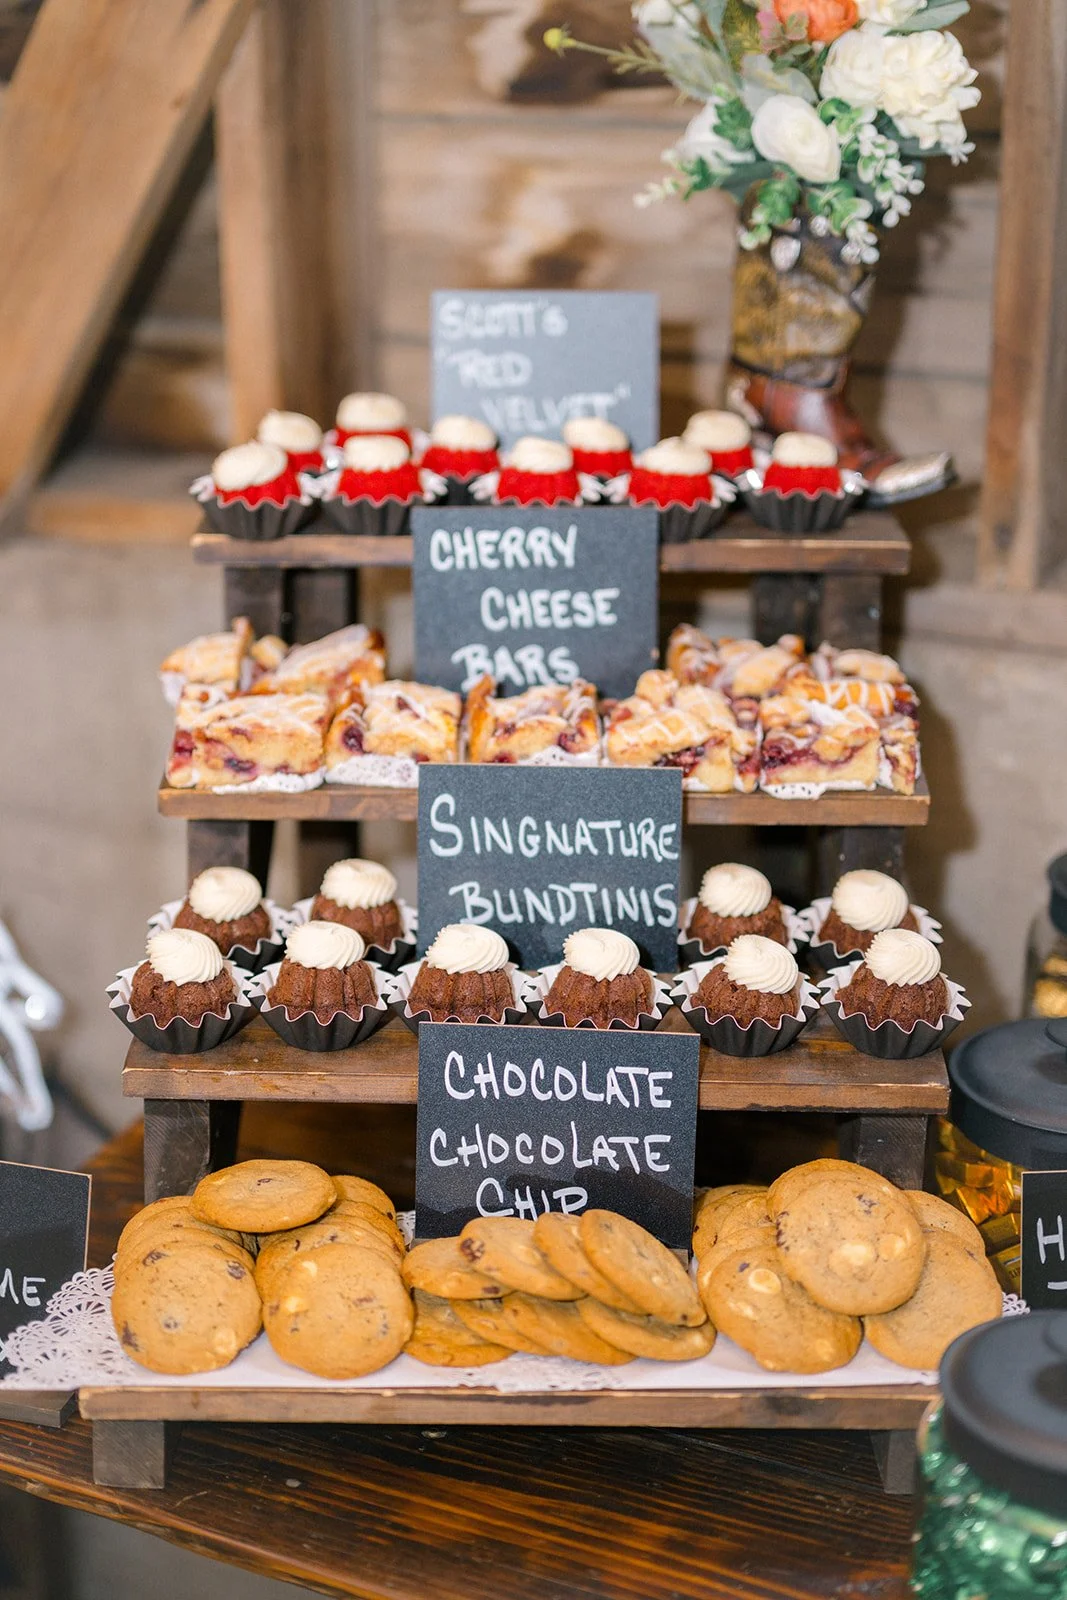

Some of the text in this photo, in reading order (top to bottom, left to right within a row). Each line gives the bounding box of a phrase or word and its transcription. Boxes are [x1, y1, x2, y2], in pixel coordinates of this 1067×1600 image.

[429, 523, 578, 573] CHERRY
[479, 586, 621, 633] CHEESE
[451, 643, 580, 694] BARS
[429, 793, 679, 863] SINGNATURE
[449, 881, 678, 928] BUNDTINIS
[444, 1050, 673, 1109] CHOCOLATE
[429, 1120, 671, 1175] CHOCOLATE
[475, 1177, 588, 1222] CHIP
